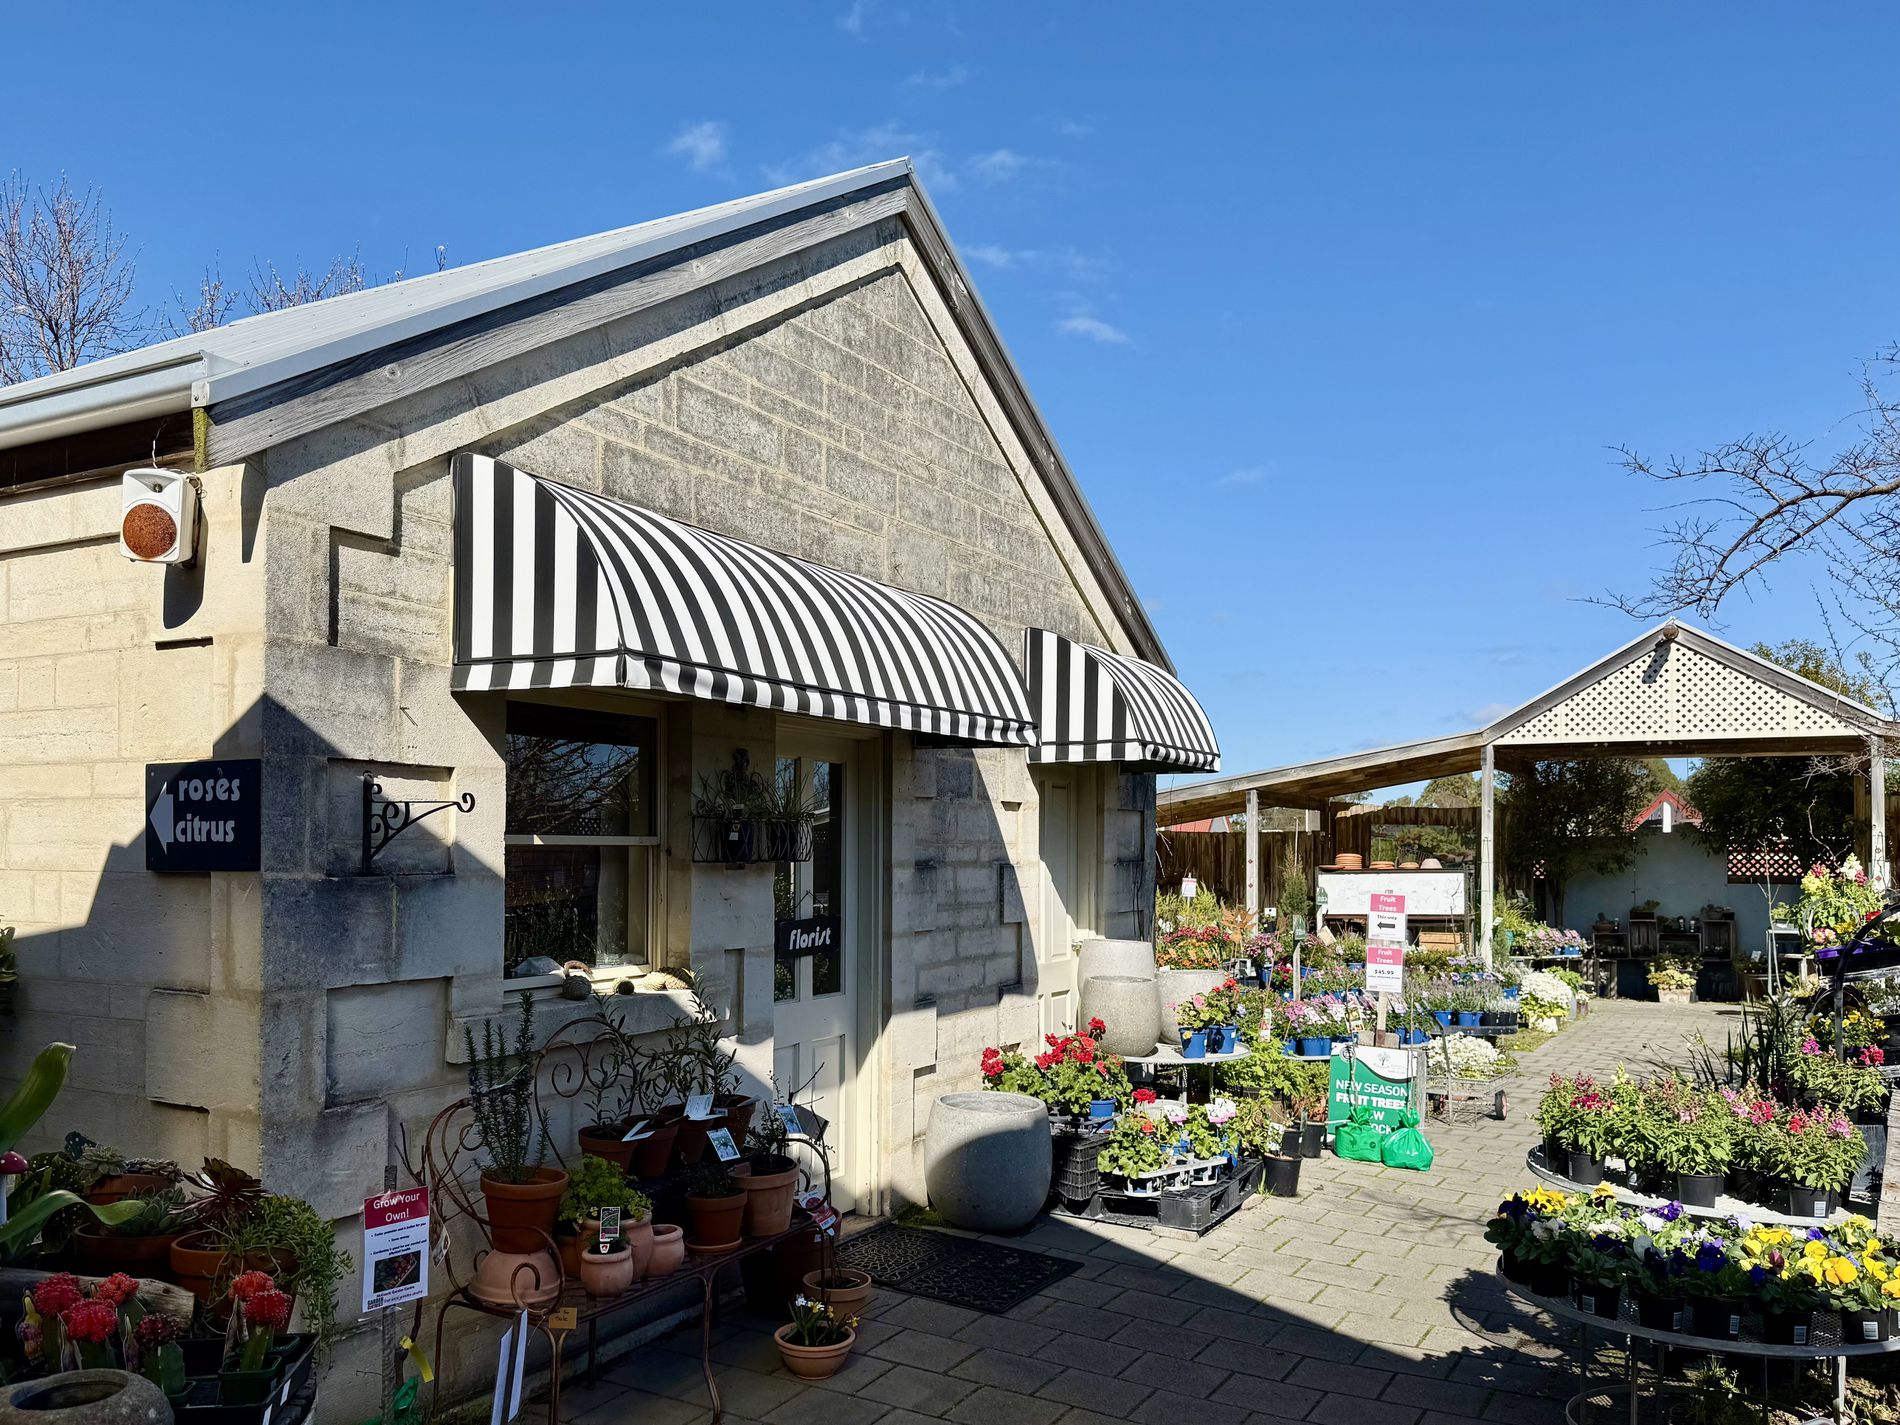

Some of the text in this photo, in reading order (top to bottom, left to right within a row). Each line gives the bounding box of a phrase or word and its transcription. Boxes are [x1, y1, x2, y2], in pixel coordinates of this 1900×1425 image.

[178, 778, 241, 802] roses
[175, 813, 235, 843] citrus
[1380, 895, 1396, 903] Fruit
[1378, 904, 1397, 912] Trees
[789, 926, 831, 950] florist
[1336, 1079, 1408, 1096] NEW SEASON
[373, 1193, 420, 1210] Grow Your
[385, 1208, 409, 1222] Own!
